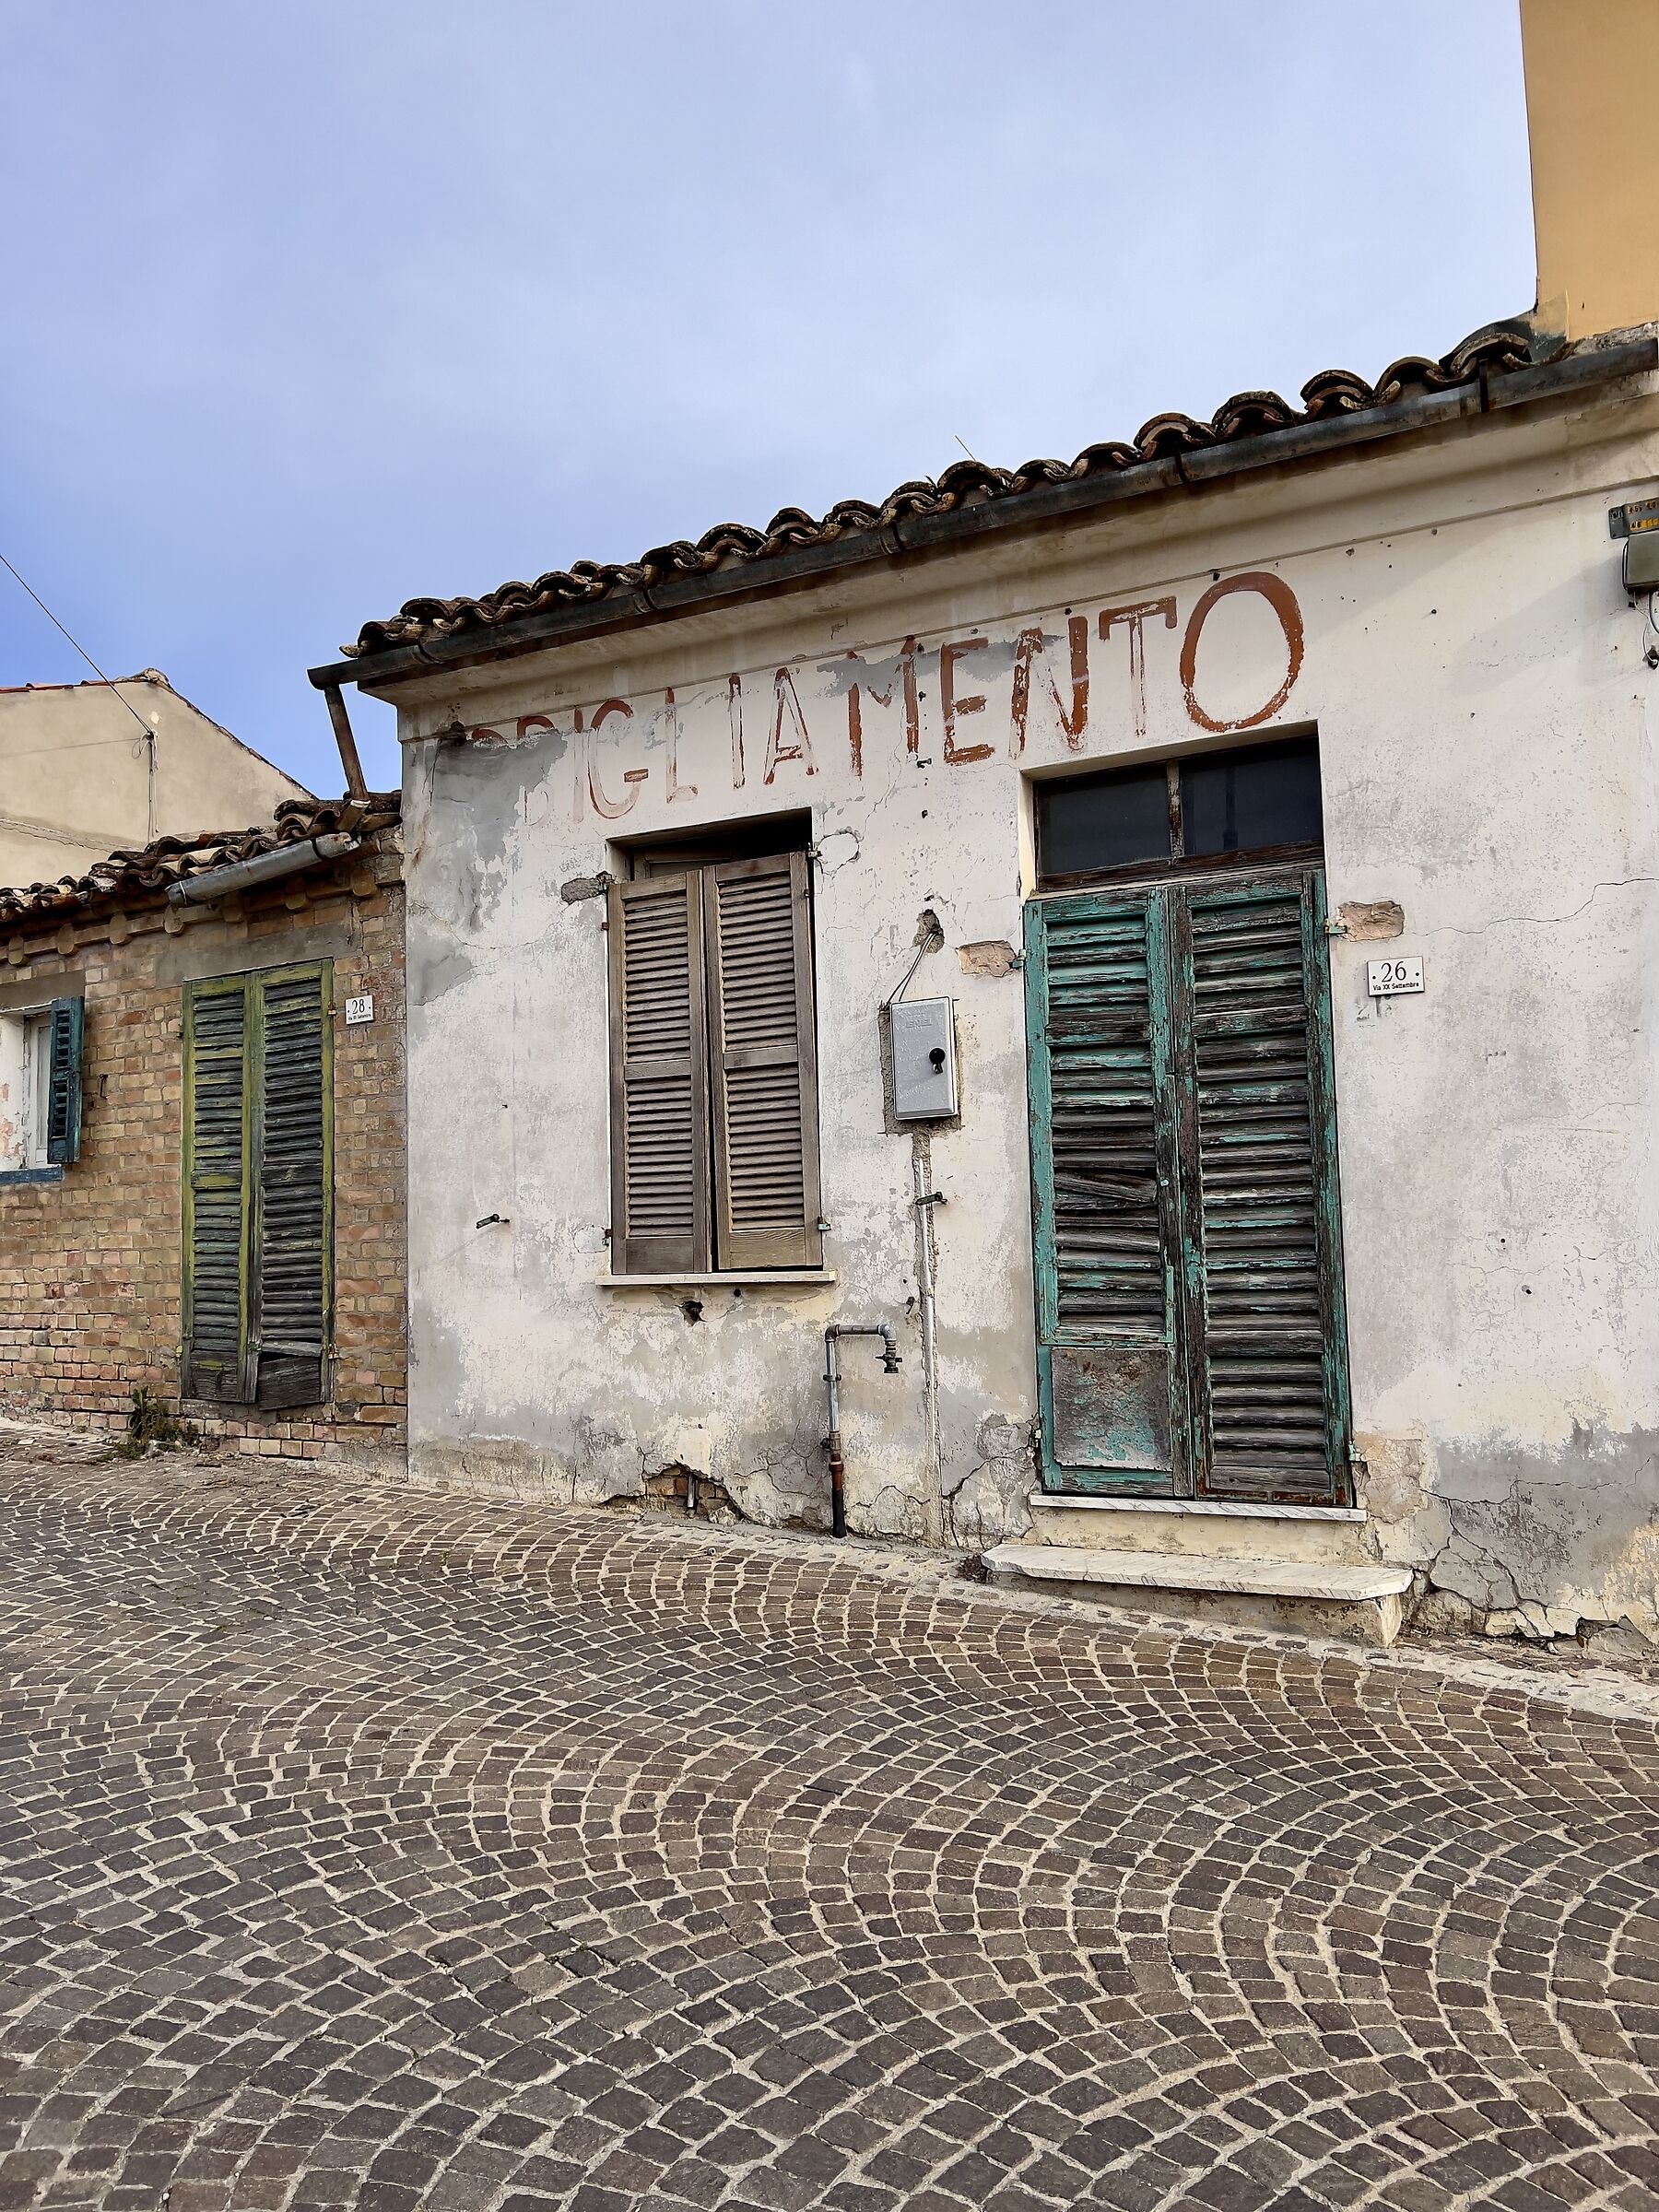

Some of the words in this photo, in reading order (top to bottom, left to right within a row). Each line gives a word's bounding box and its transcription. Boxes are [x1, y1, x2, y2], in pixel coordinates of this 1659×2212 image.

[1381, 960, 1406, 982] 26
[1392, 982, 1419, 990] Settembre
[351, 998, 365, 1015] 28
